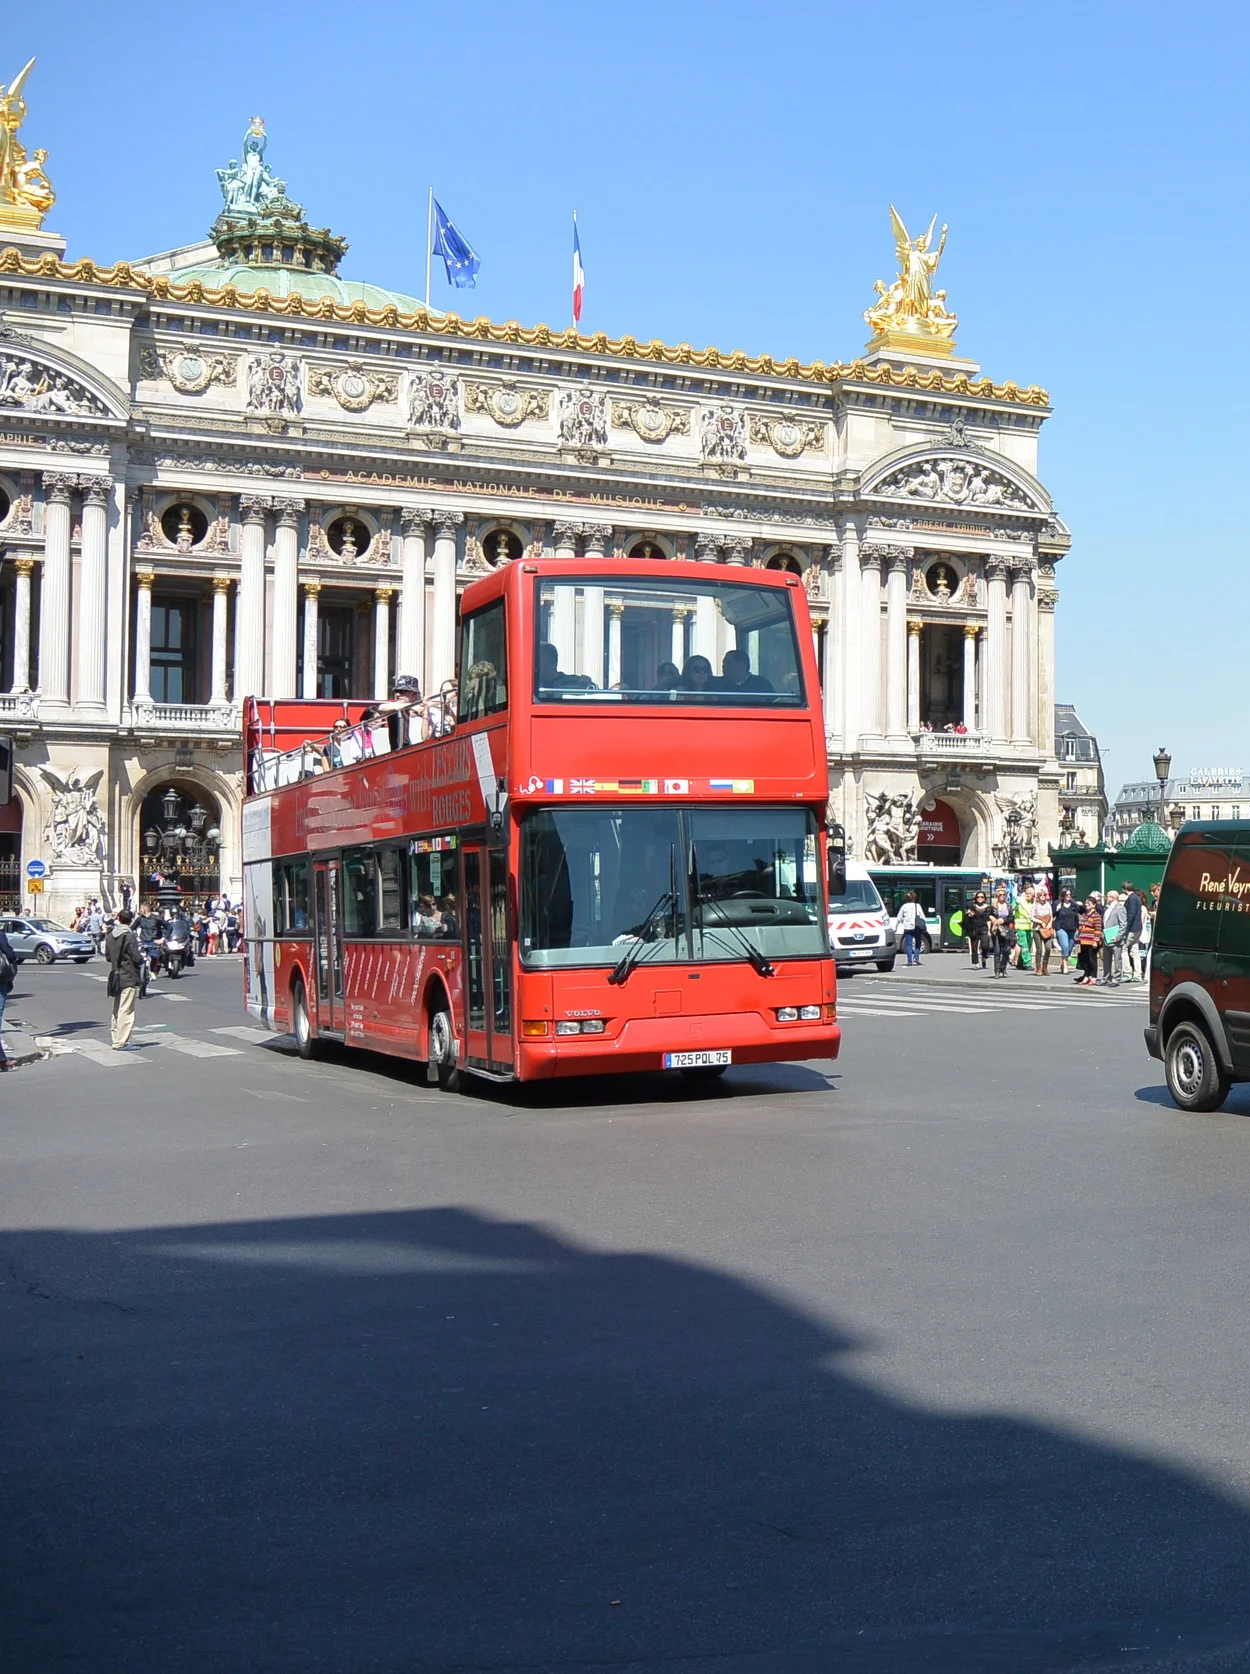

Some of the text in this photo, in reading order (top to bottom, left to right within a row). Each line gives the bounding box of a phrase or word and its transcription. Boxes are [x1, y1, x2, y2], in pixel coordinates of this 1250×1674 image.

[345, 470, 665, 510] ACADEMIE NATIONALE DE MUSIQUE
[1199, 872, 1227, 893] René
[564, 1009, 602, 1018] VOLVO
[674, 1054, 694, 1066] 725
[716, 1051, 729, 1064] 75
